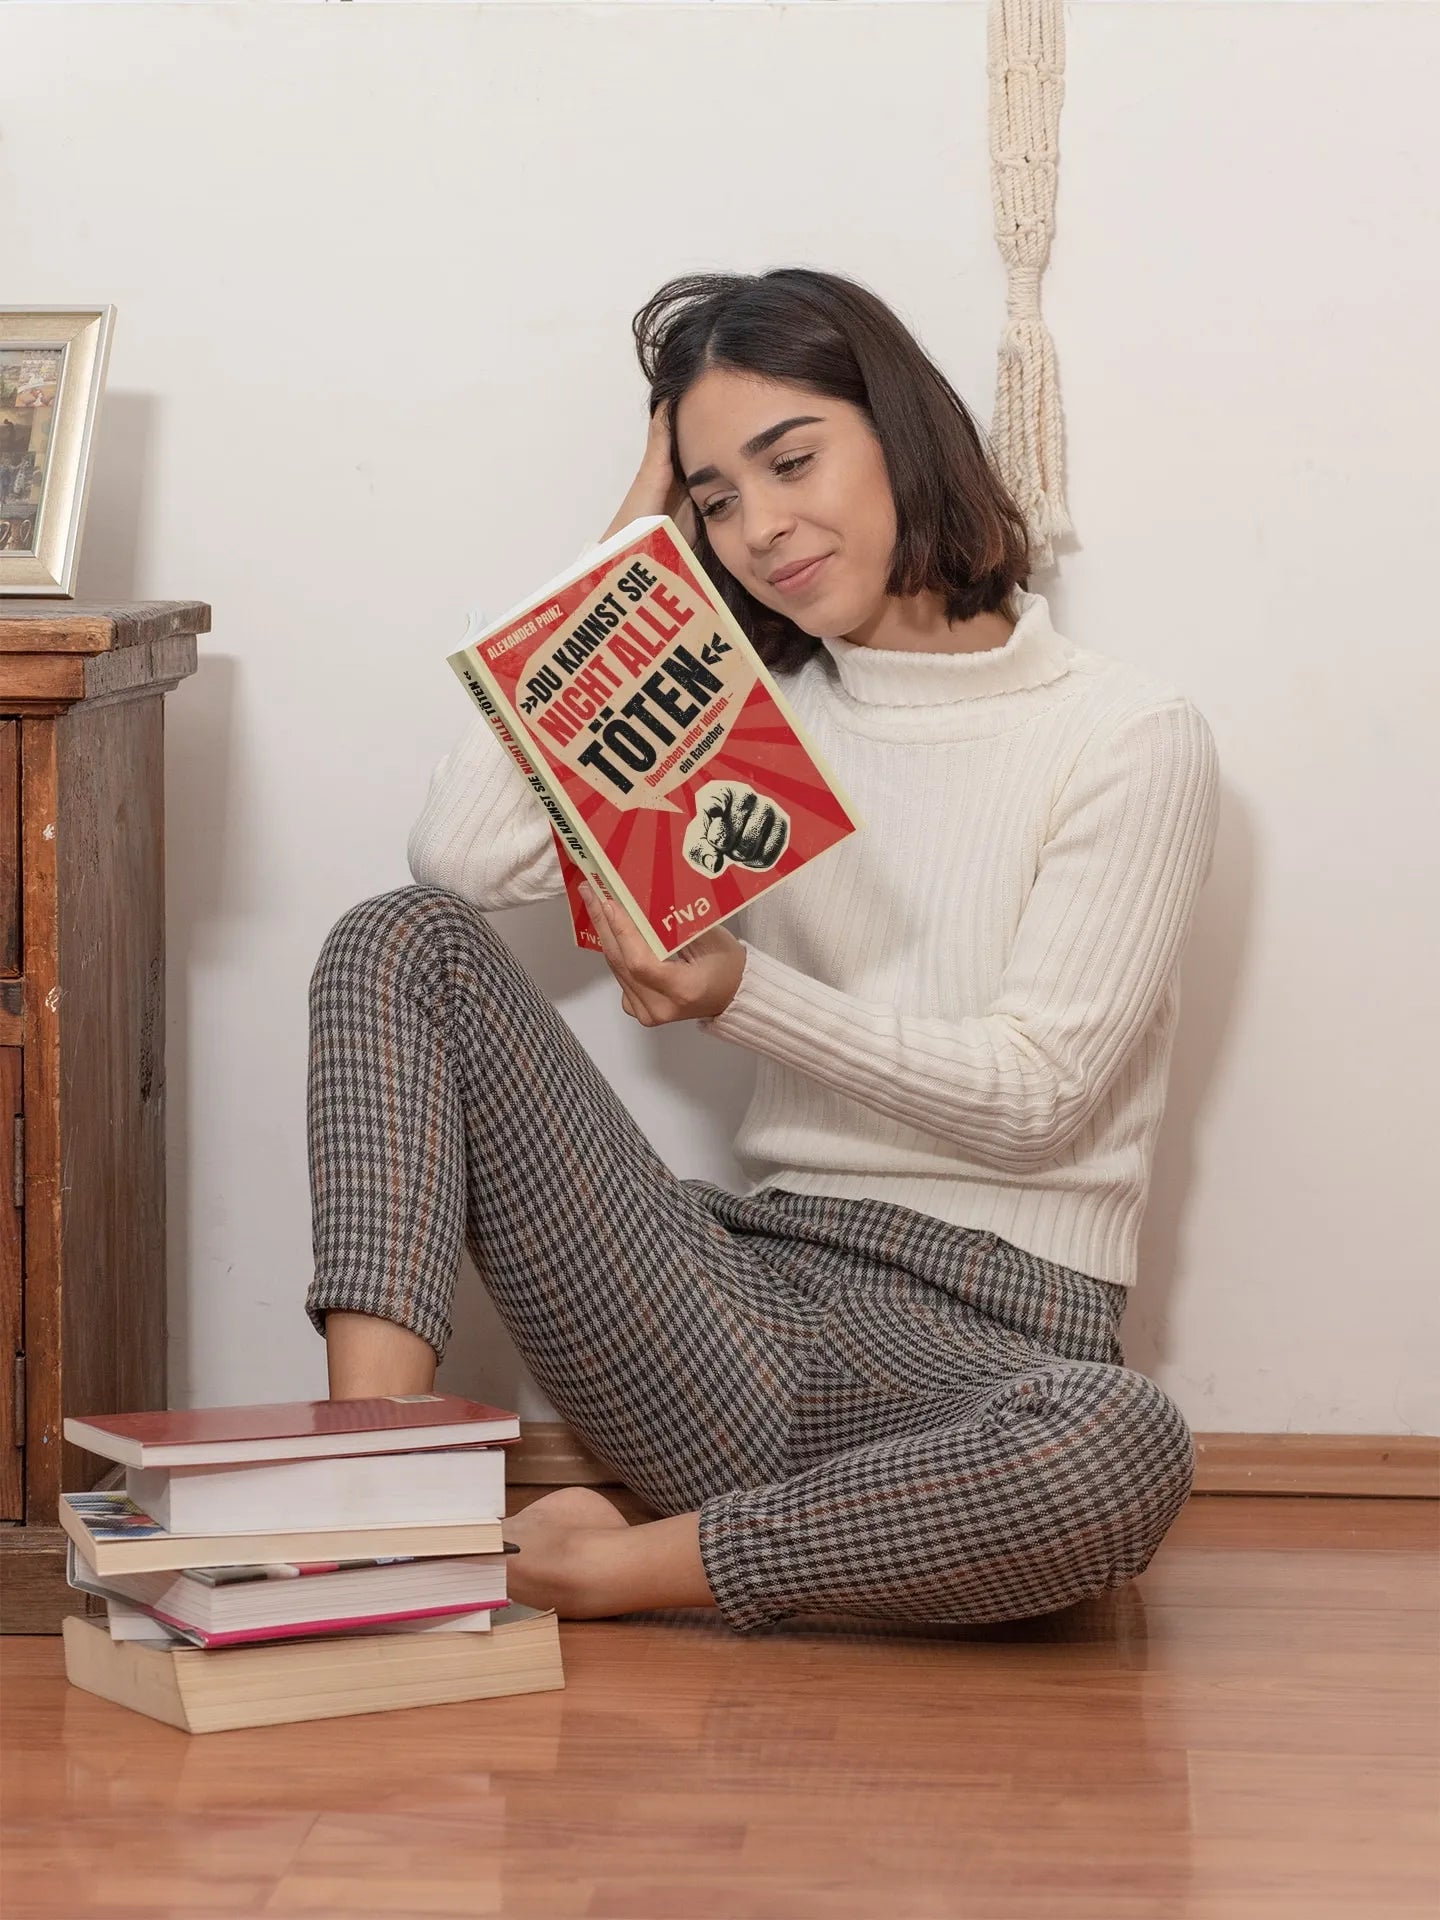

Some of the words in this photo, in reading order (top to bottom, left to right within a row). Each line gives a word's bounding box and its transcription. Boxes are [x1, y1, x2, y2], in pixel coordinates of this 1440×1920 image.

[487, 621, 537, 660] ALEXANDER
[535, 604, 563, 629] PRINZ
[552, 592, 628, 675] KANNST
[617, 561, 658, 602] SIE
[537, 654, 623, 748] NICHT
[606, 583, 695, 679] ALLE
[490, 716, 514, 742] ALLE
[644, 746, 686, 787] Überleben
[682, 724, 704, 748] unter
[700, 697, 729, 727] Idioten
[679, 758, 695, 774] ein
[690, 723, 725, 761] Ratgeber
[508, 745, 534, 774] NICHT
[528, 776, 546, 792] SIE
[540, 795, 573, 834] KANNST
[662, 897, 710, 931] riva
